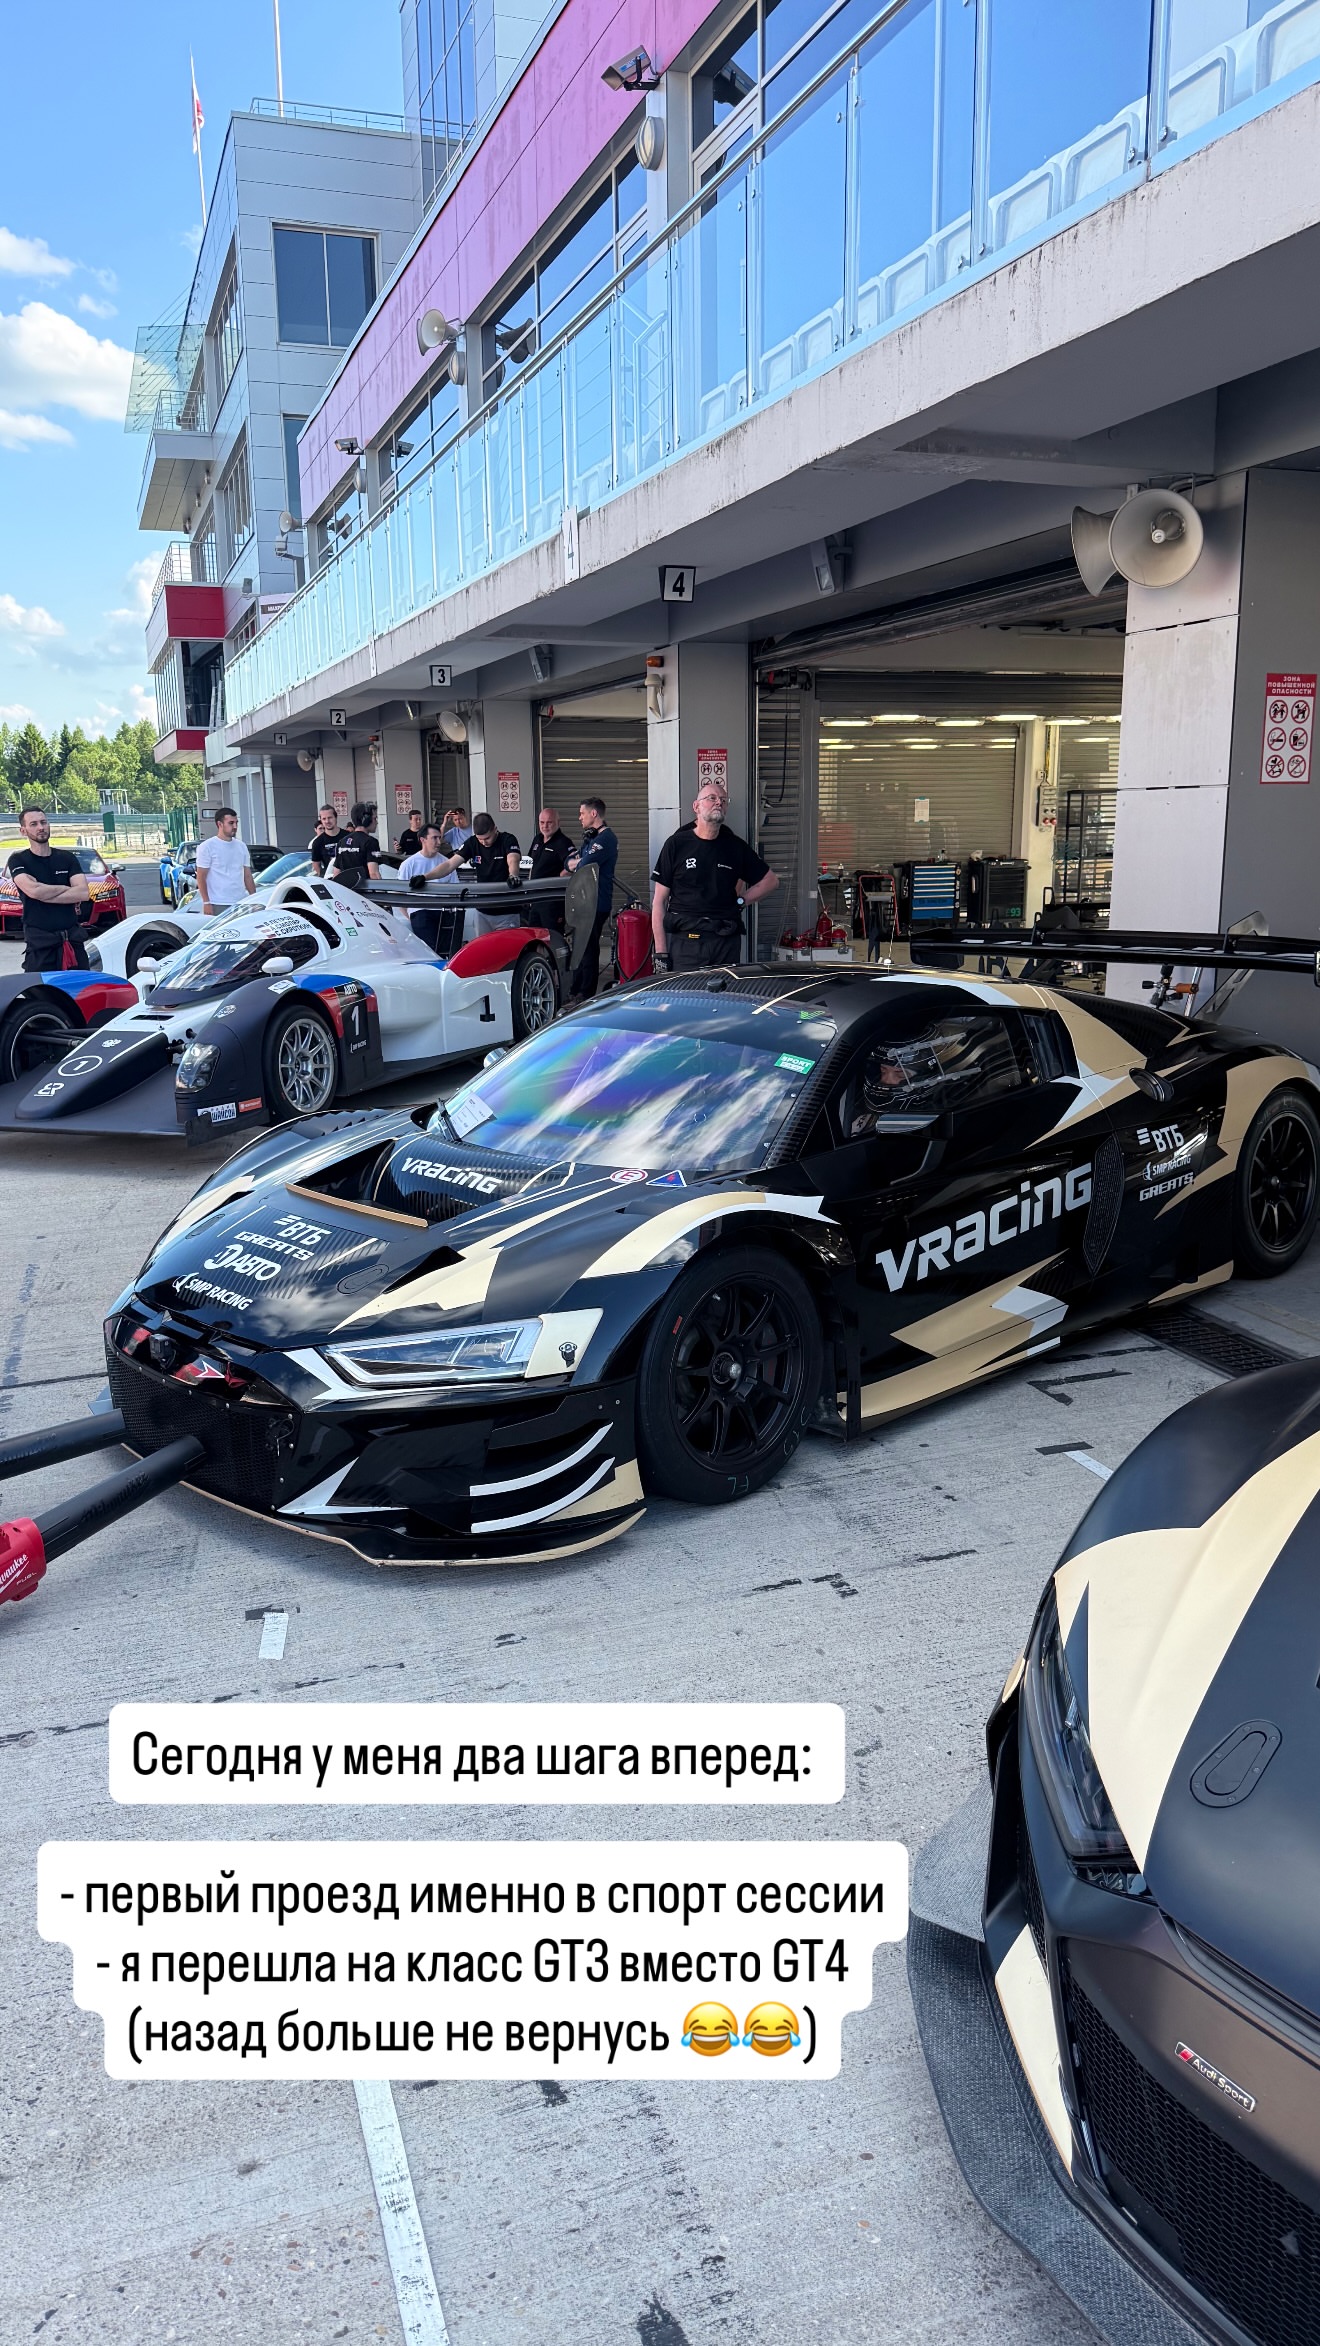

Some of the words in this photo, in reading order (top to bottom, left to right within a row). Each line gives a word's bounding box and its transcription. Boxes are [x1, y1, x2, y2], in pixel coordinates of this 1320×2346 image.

[672, 571, 685, 598] 4
[437, 668, 446, 684] 3
[1267, 681, 1316, 689] ПОВЫШЕННОЙ
[335, 712, 342, 724] 2
[278, 735, 283, 744] 1
[351, 1005, 360, 1036] 1
[72, 1059, 89, 1072] 1
[1151, 1123, 1185, 1153] ВТБ
[1152, 1162, 1168, 1176] SMP
[1167, 1153, 1192, 1171] RACING
[1139, 1171, 1194, 1202] GREATS
[233, 1230, 315, 1261] GREATS
[276, 1221, 333, 1246] ВТБ
[185, 1277, 213, 1297] SMP
[208, 1286, 254, 1311] RACING
[0, 1553, 29, 1586] waukee
[1191, 2058, 1217, 2082] Audi
[1217, 2077, 1251, 2107] Sport
